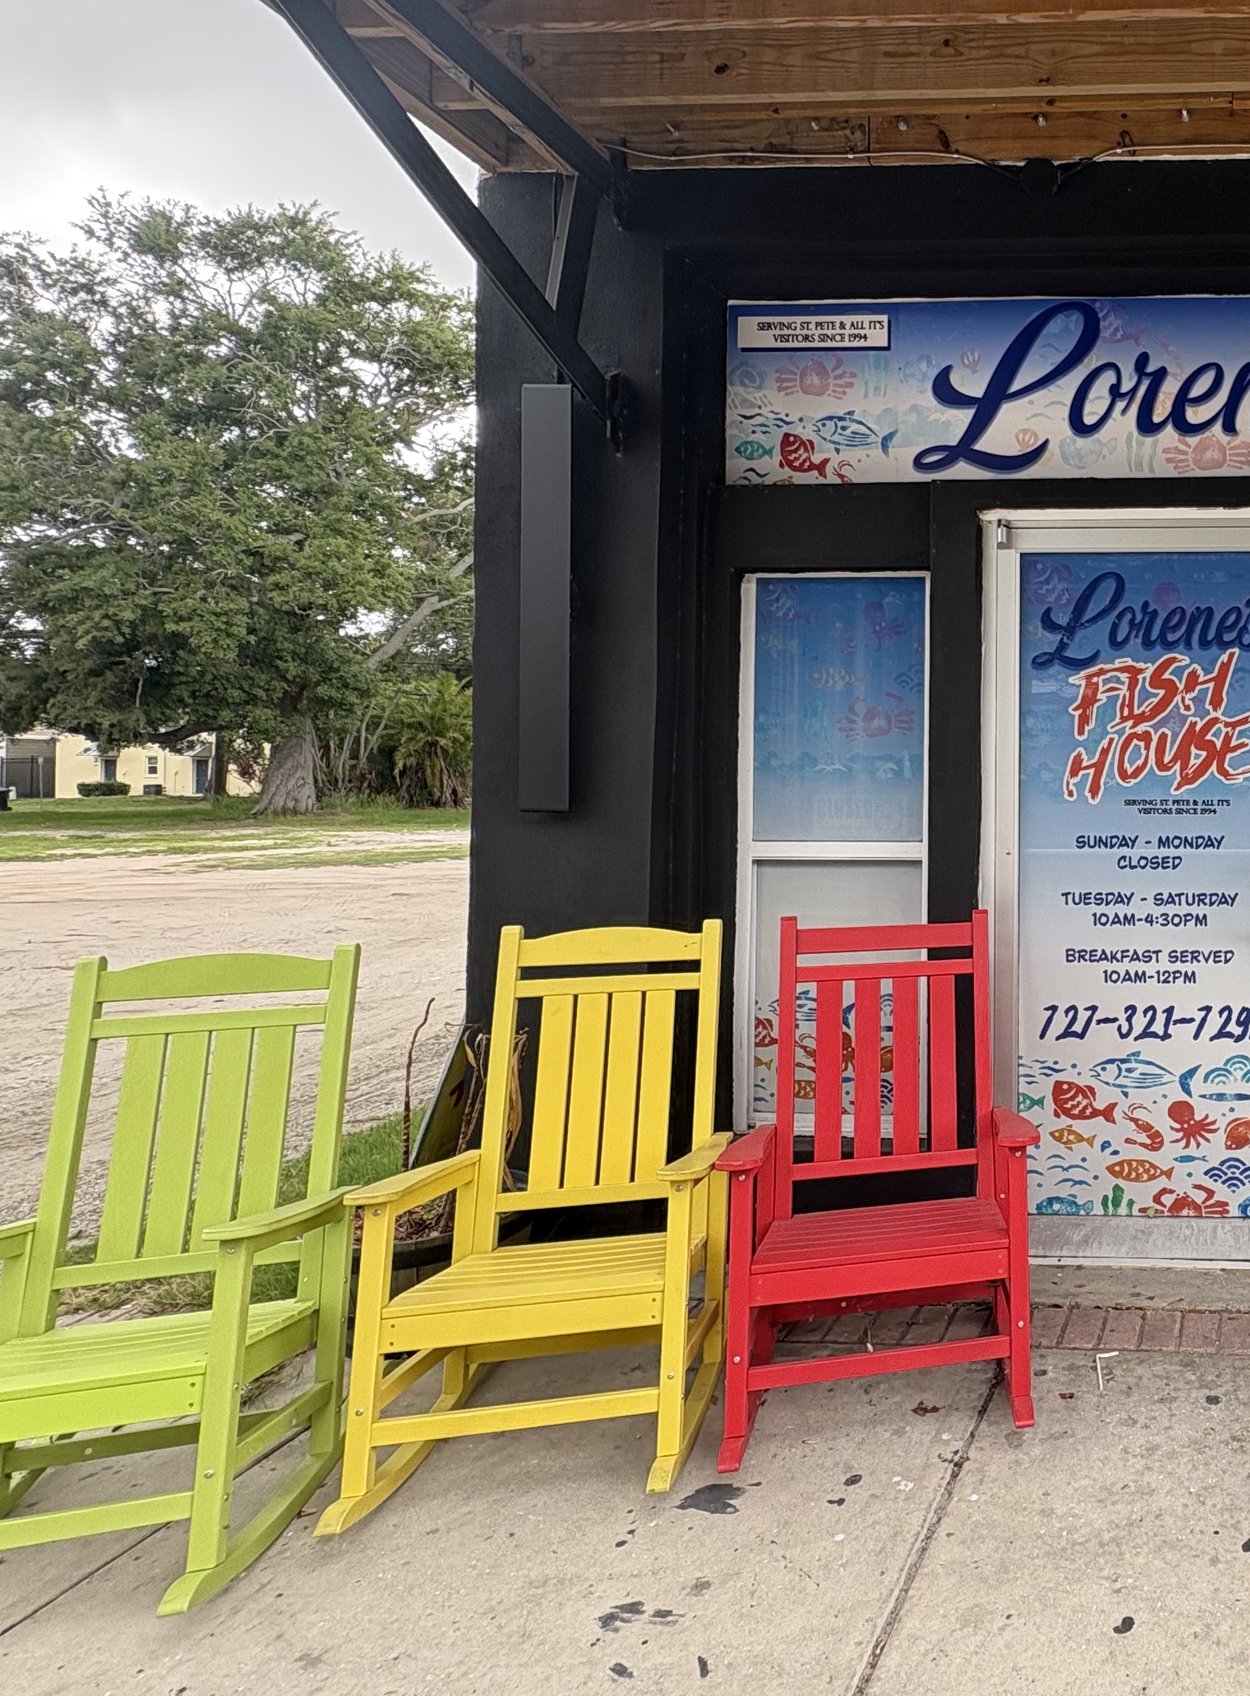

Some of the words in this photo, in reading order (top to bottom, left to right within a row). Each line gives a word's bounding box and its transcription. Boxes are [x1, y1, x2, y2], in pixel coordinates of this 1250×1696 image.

[757, 321, 797, 331] SERVING
[799, 321, 812, 331] ST.
[815, 321, 837, 331] PETE
[838, 320, 847, 331] &
[849, 320, 866, 330] ALL
[868, 320, 885, 330] IT'S
[773, 333, 815, 343] VISITORS
[818, 333, 845, 343] SINCE
[848, 333, 868, 342] 1994
[1069, 649, 1239, 739] FISH
[1123, 799, 1158, 807] SERVING
[1172, 799, 1191, 807] PETE
[1192, 799, 1200, 807] &
[1201, 799, 1215, 807] ALL
[1137, 807, 1173, 815] VISITORS
[1174, 807, 1199, 815] SINCE
[1200, 807, 1217, 815] 1994
[1075, 834, 1140, 850] SUNDAY
[1157, 834, 1226, 850] MONDAY
[1116, 855, 1183, 870] CLOSED
[1061, 891, 1135, 907] TUESDAY
[1152, 891, 1239, 907] SATURDAY
[1091, 912, 1209, 928] 10AM-4:30PM
[1065, 949, 1163, 964] BREAKFAST
[1167, 949, 1235, 965] SERVED
[1102, 969, 1197, 984] 10AM-12PM
